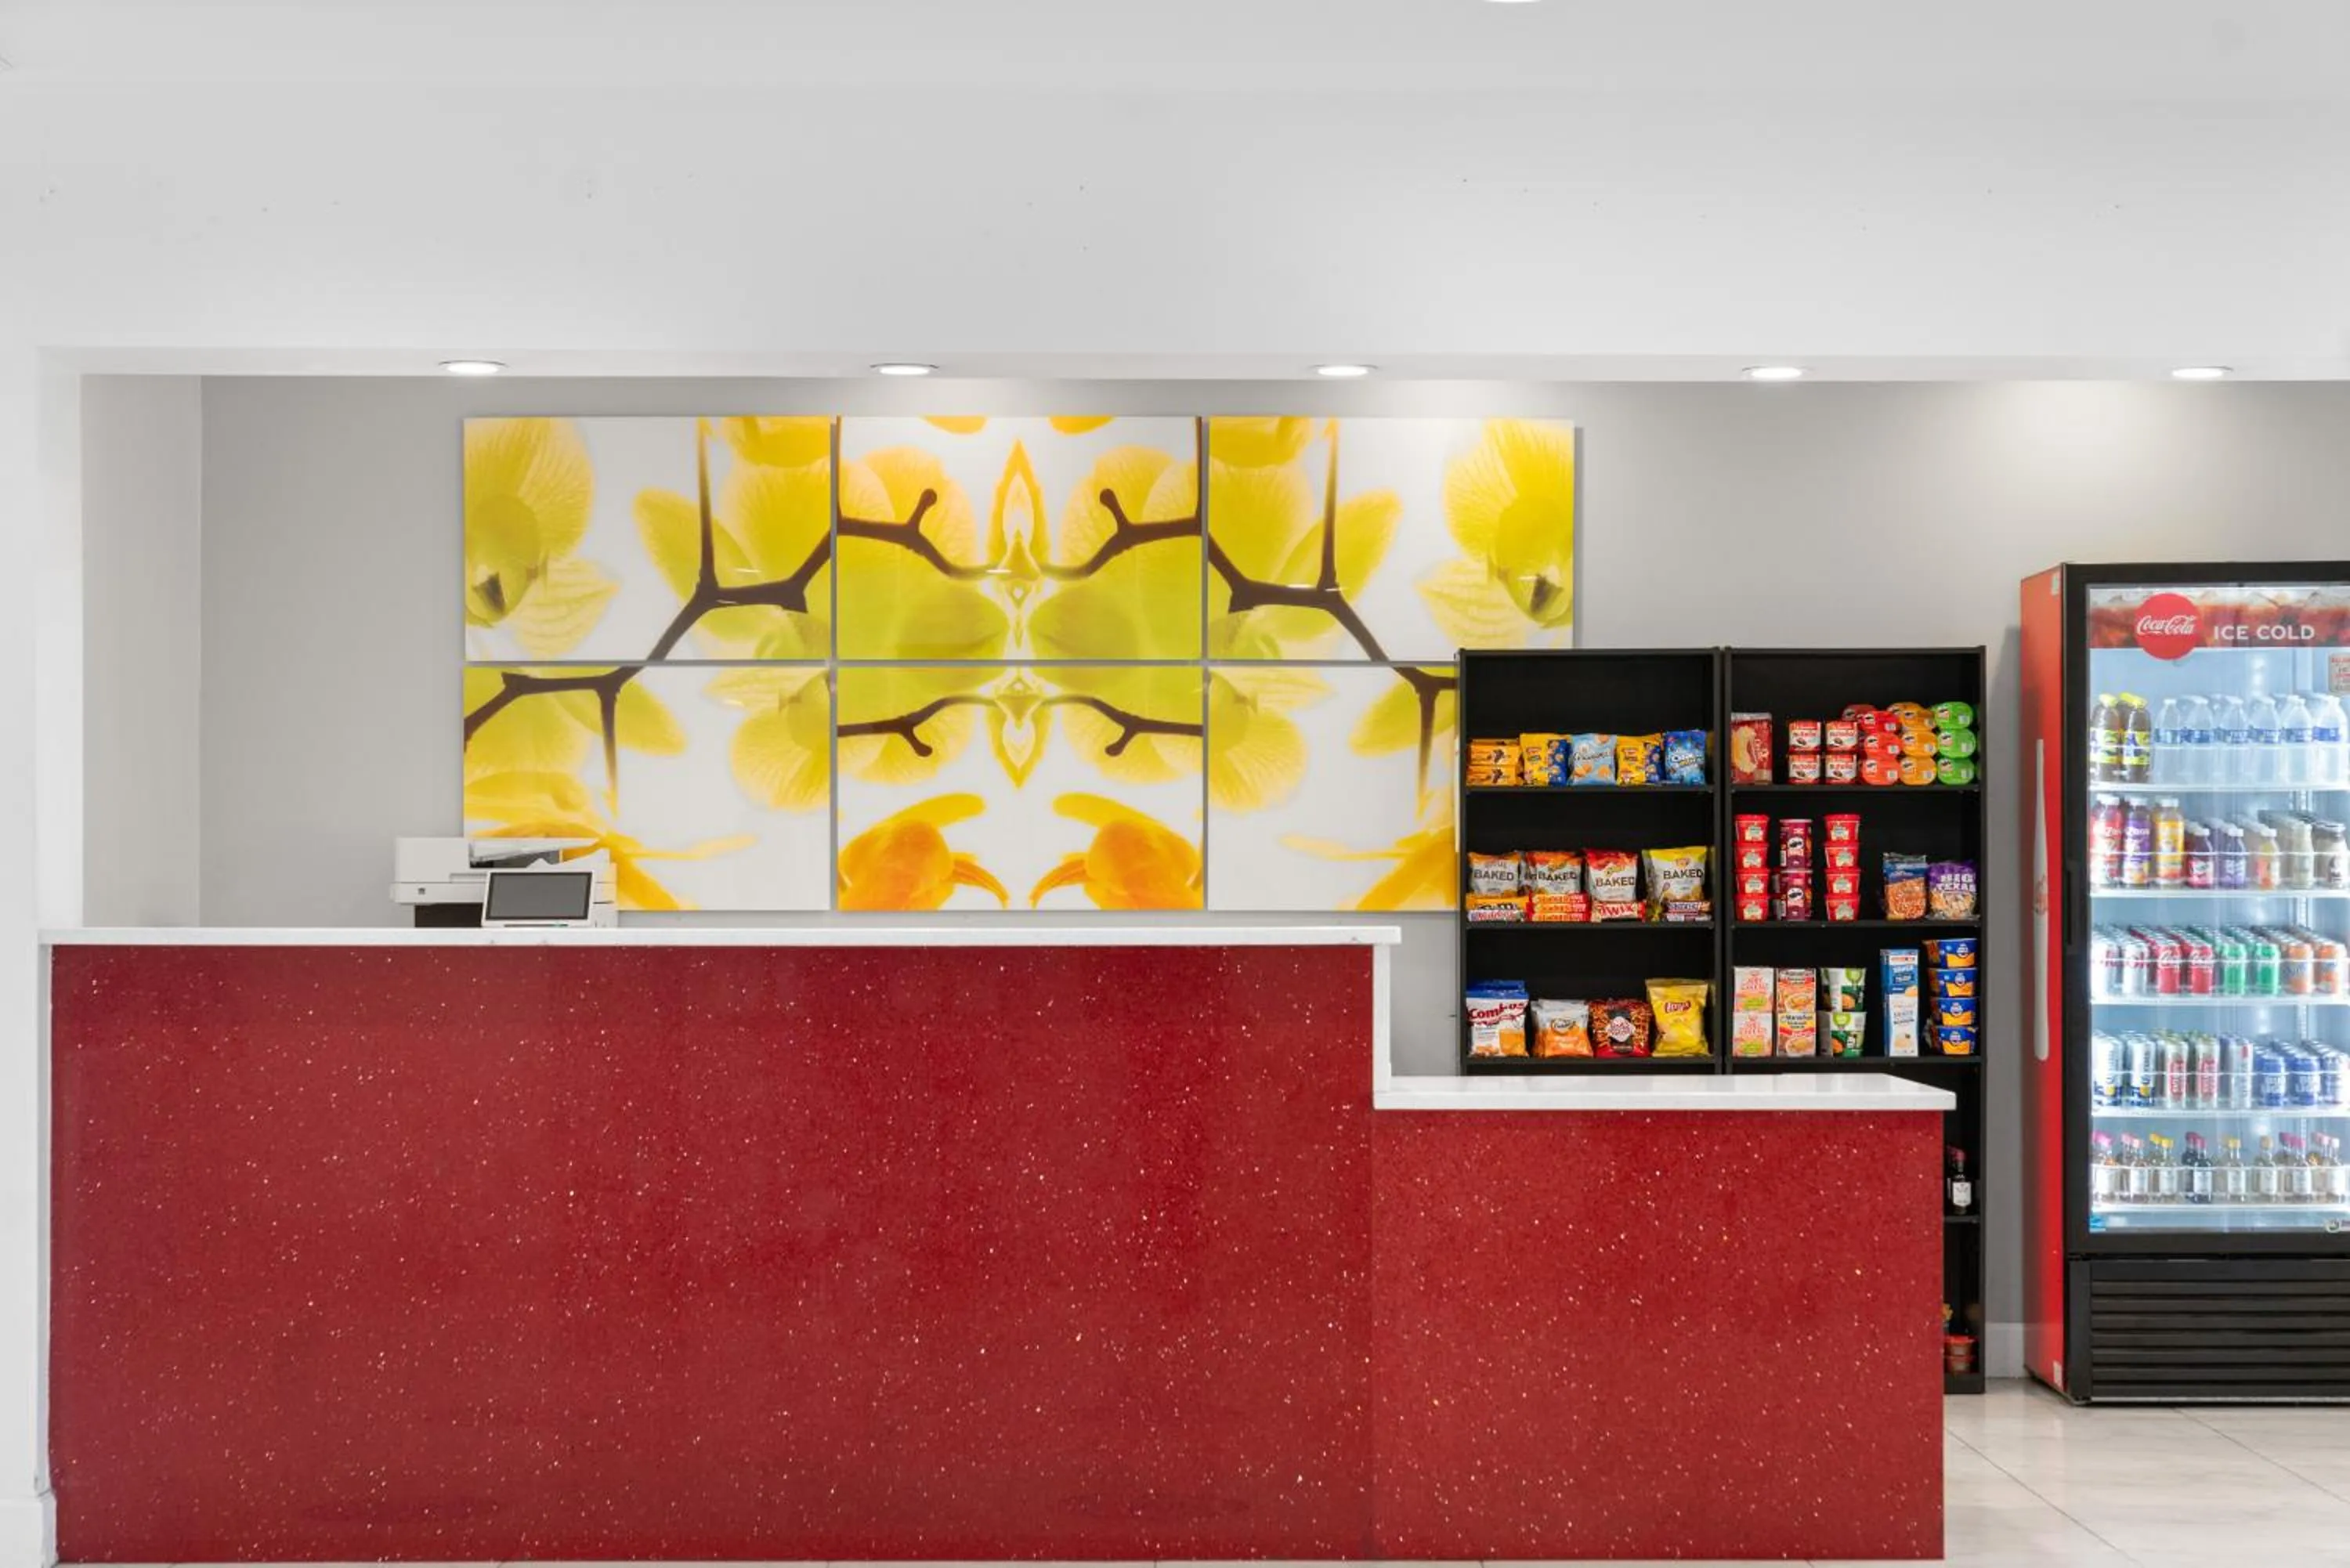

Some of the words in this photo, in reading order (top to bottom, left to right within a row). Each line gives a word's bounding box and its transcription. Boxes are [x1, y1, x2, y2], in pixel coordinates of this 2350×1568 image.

[2214, 625, 2249, 640] ICE
[2256, 625, 2315, 640] COLD
[1473, 869, 1514, 881] BAKED
[1538, 870, 1577, 882] BAKED
[1663, 869, 1704, 880] BAKED
[1596, 876, 1635, 887] BAKED
[1599, 902, 1634, 916] TWIX
